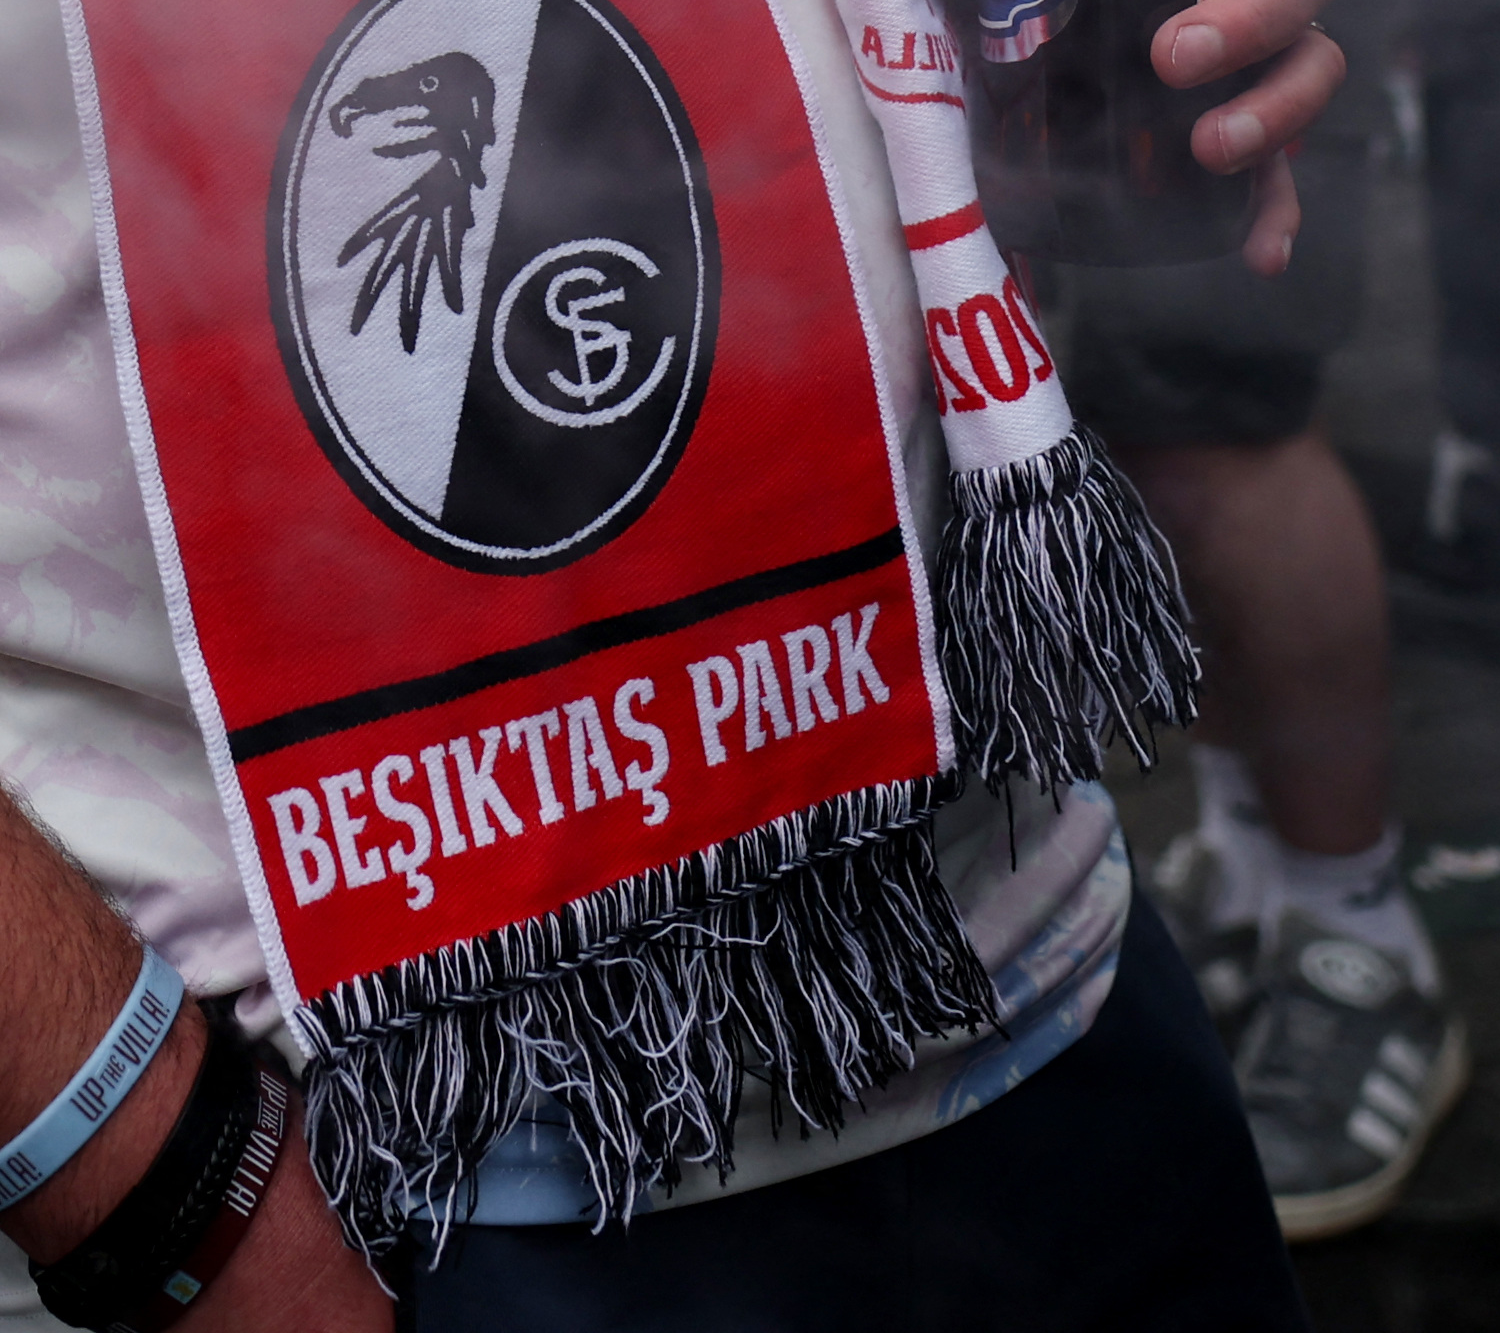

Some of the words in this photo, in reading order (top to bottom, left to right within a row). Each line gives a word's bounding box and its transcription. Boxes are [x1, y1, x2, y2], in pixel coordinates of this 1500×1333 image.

[686, 601, 892, 769] PARK
[112, 988, 171, 1067] VILLA!
[69, 1074, 110, 1123] UP
[100, 1053, 127, 1090] THE
[259, 1070, 288, 1112] UP
[222, 1129, 282, 1218] VILLA!
